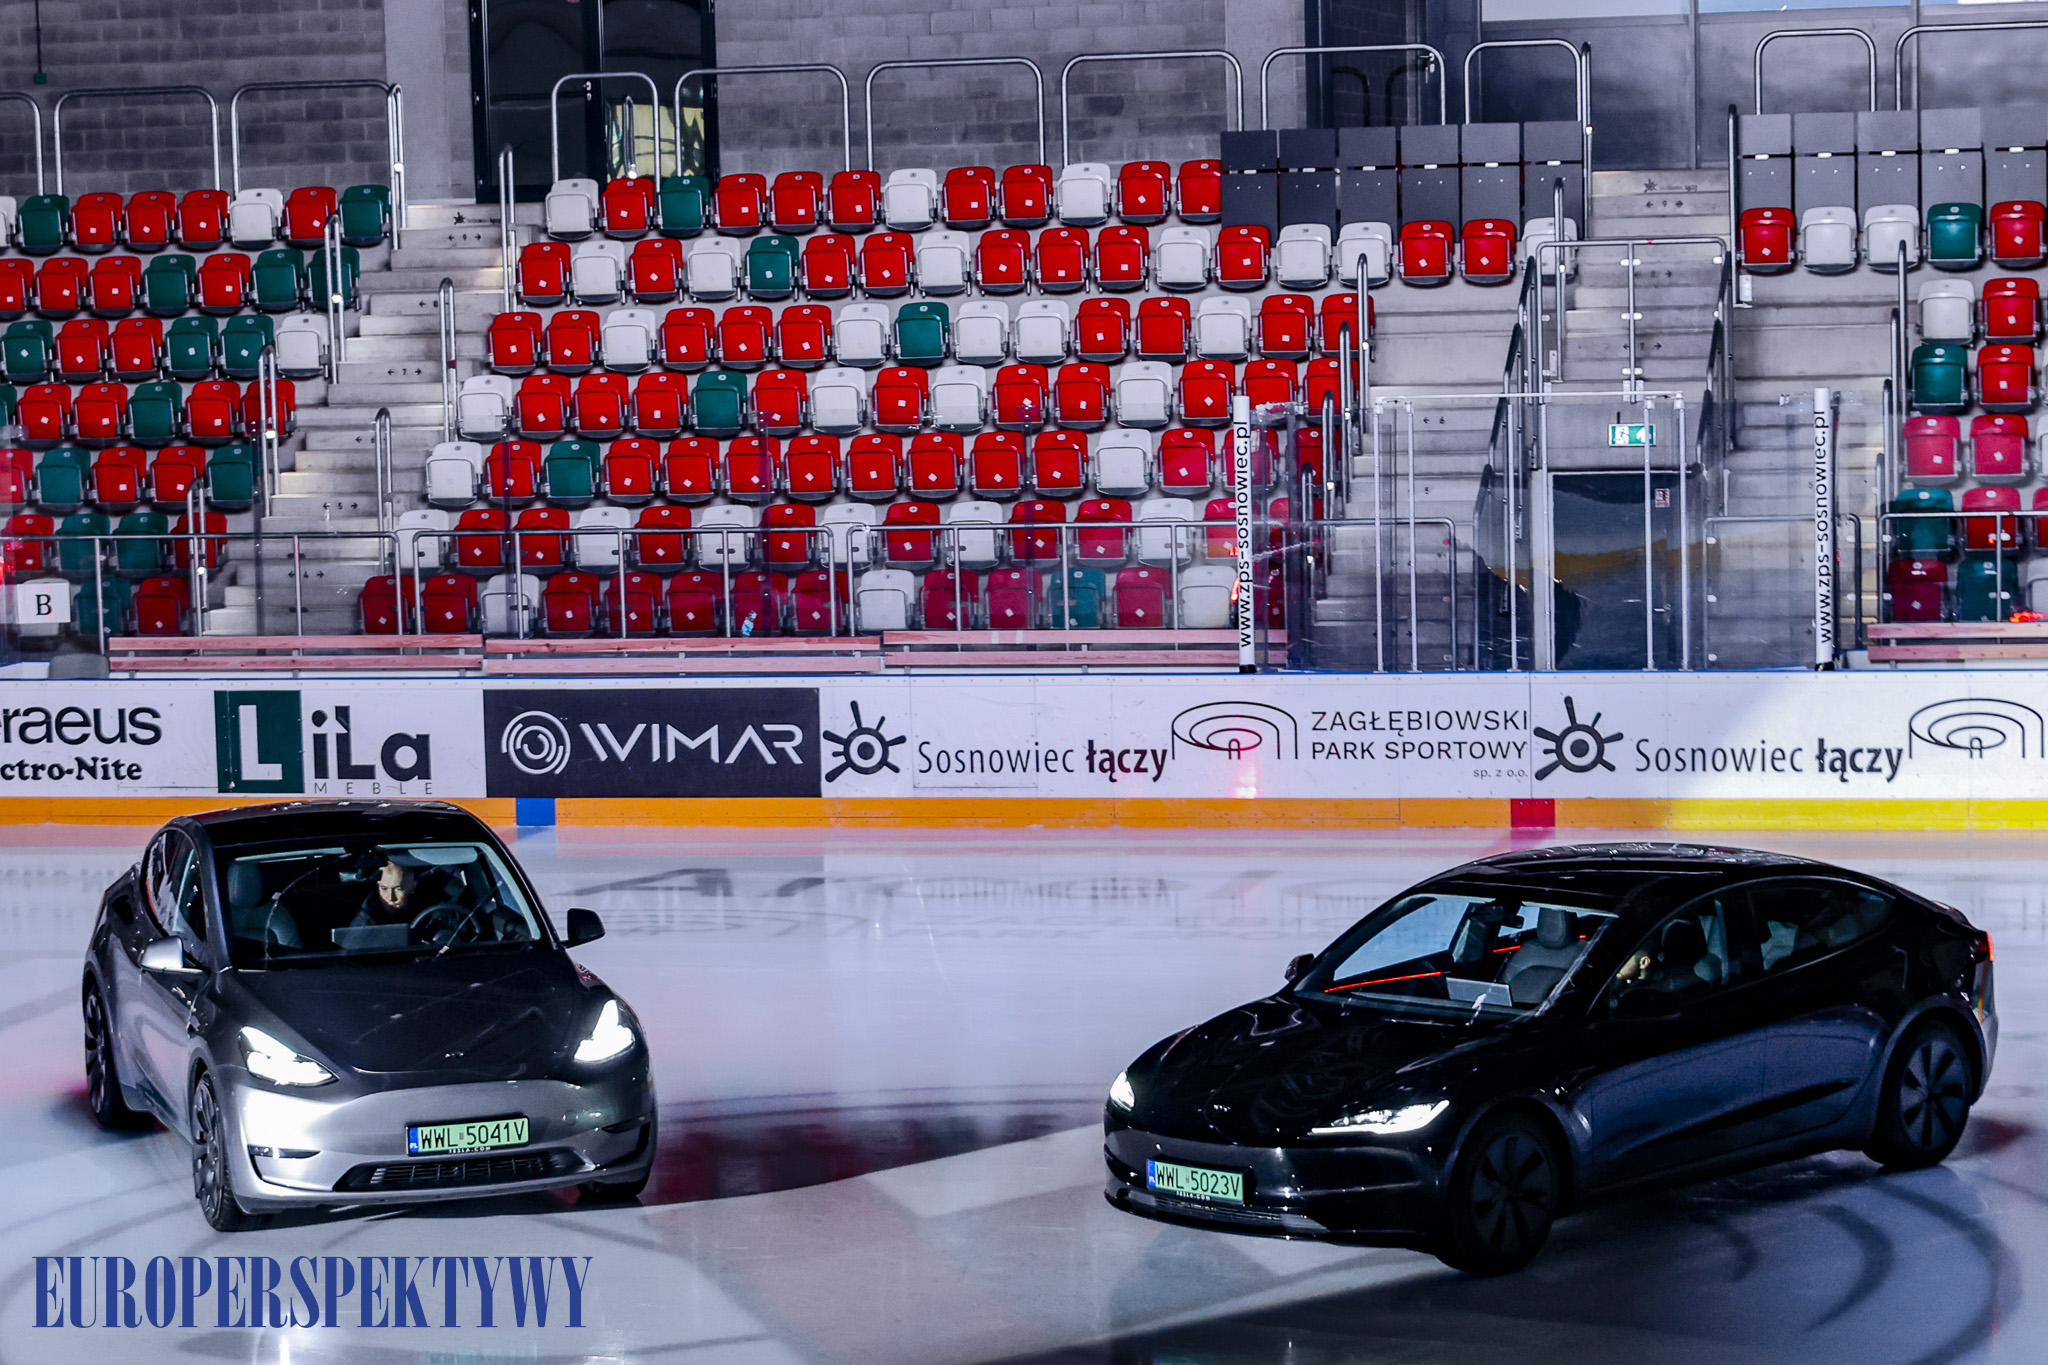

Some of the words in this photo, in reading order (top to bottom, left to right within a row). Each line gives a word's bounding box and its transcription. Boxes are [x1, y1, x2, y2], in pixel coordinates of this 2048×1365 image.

[1234, 421, 1252, 648] www.zps-sosnowiec.pl
[1814, 411, 1832, 644] www.zps-sosnowiec.pl
[35, 594, 52, 616] B
[0, 706, 162, 745] raeus
[1311, 710, 1528, 737] ZAGŁĘBIOWSKI
[579, 723, 804, 765] WIMAR
[918, 741, 1075, 774] Sosnowiec
[1085, 739, 1168, 783] łączy
[1312, 741, 1376, 760] PARK
[1384, 741, 1528, 760] SPORTOWY
[1635, 738, 1803, 773] Sosnowiec
[1815, 737, 1904, 783] łączy
[314, 781, 433, 795] MEBLE
[1473, 769, 1491, 780] sp.
[1496, 769, 1502, 777] z
[1506, 769, 1528, 778] o.o.
[420, 1127, 459, 1149] WWL
[466, 1120, 525, 1146] 5041V
[1156, 1164, 1185, 1190] WWL
[1190, 1170, 1240, 1198] 5023V
